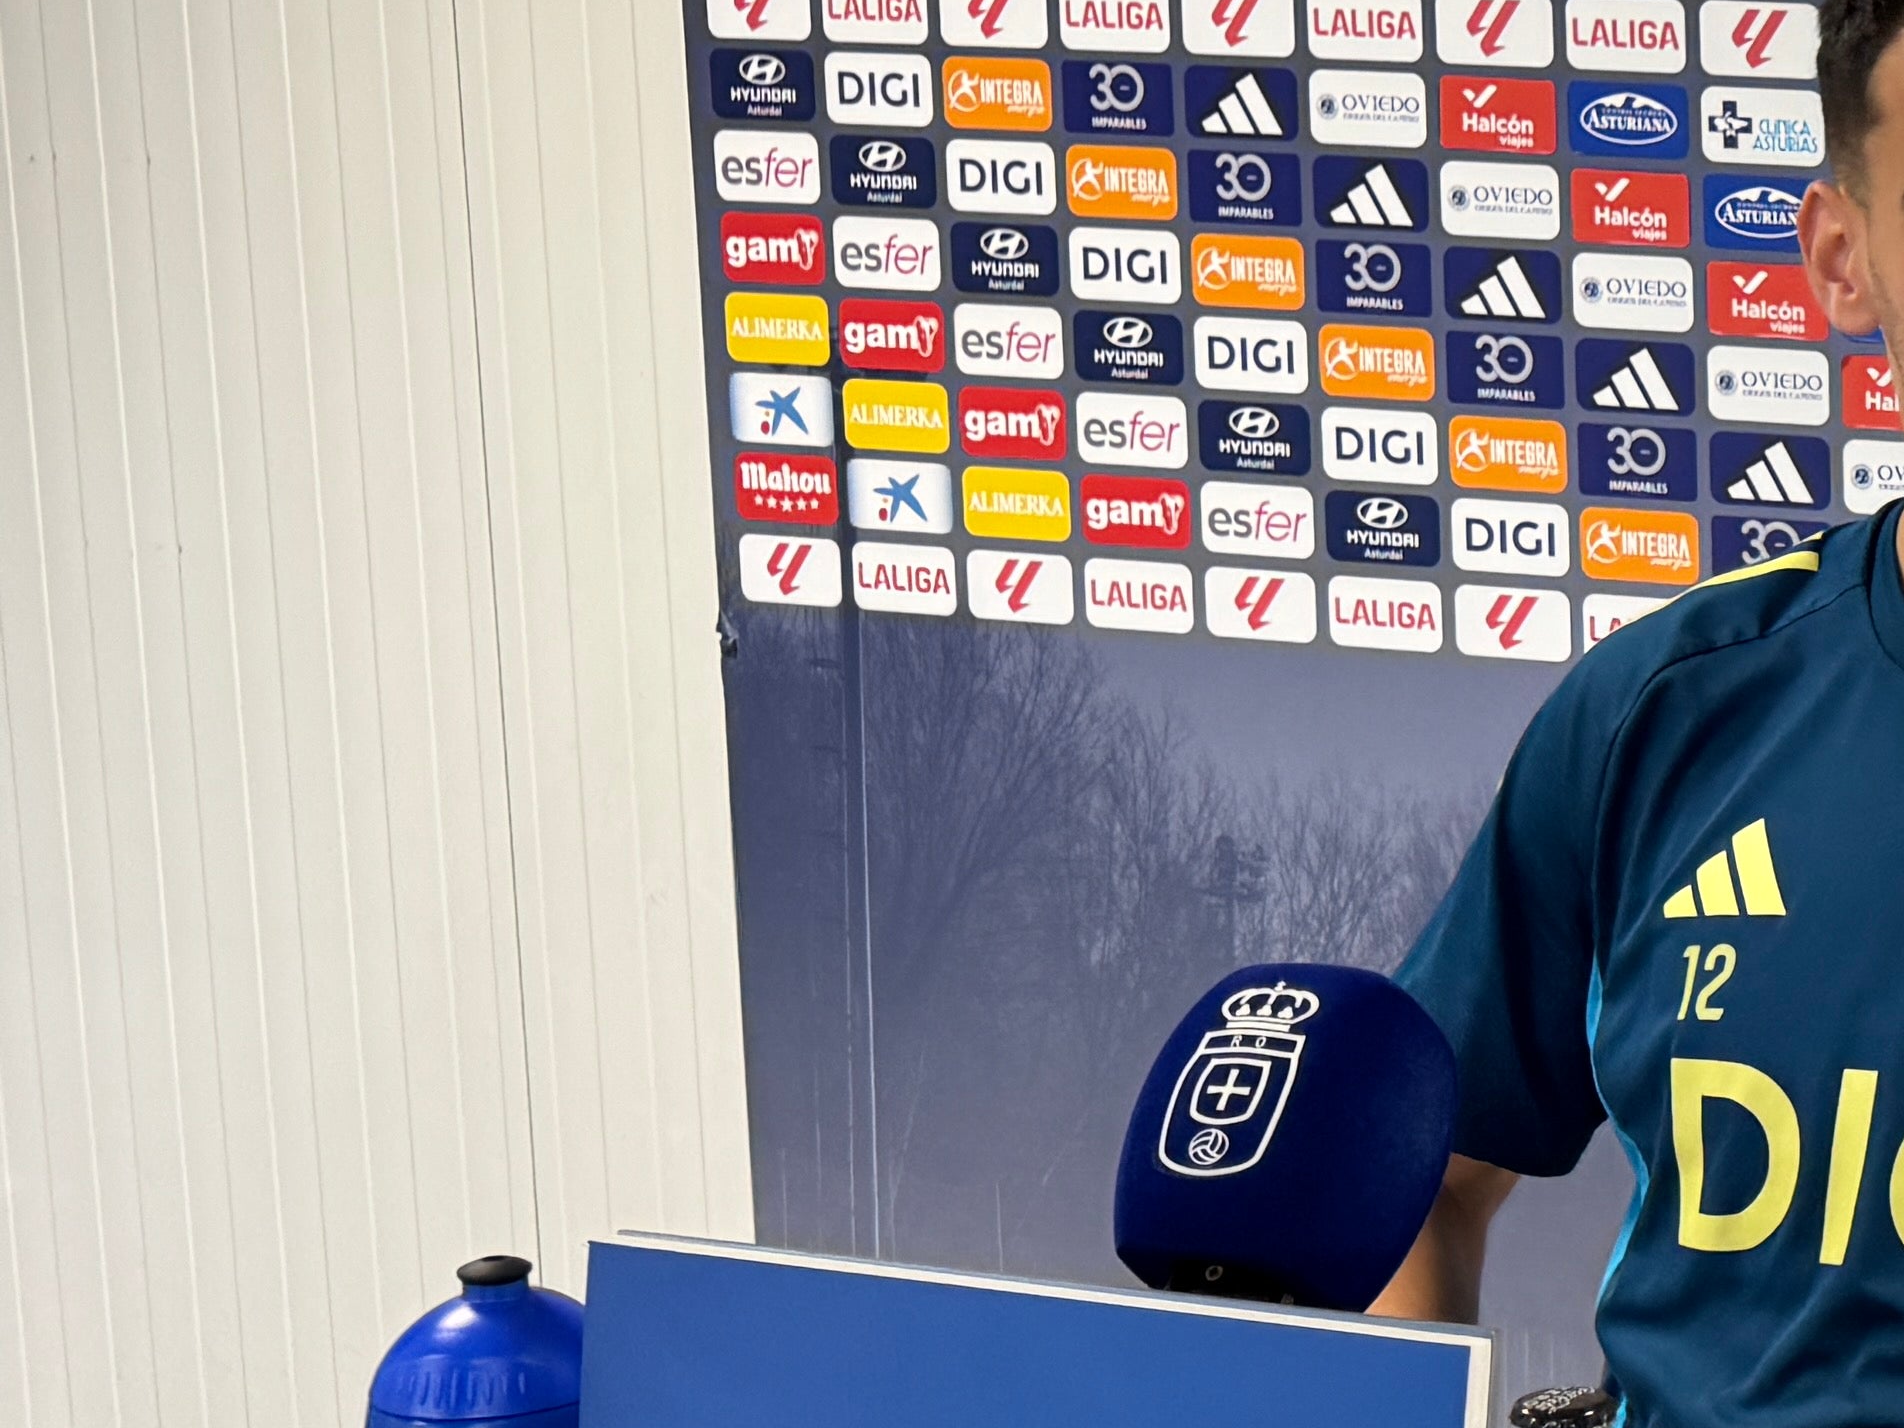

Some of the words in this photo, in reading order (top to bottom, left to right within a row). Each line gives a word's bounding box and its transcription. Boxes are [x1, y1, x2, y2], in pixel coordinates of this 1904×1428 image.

[730, 86, 796, 104] HYUNDAI
[838, 72, 919, 106] DIGI
[980, 78, 1044, 105] INTEGRA
[1463, 112, 1533, 134] Halcón
[1500, 135, 1533, 148] viajes
[734, 319, 821, 339] ALIMERKA
[1336, 427, 1423, 464] DIGI
[741, 462, 831, 495] Mahou
[1209, 502, 1306, 541] esfer
[858, 564, 951, 593] LALIGA
[1678, 943, 1737, 1022] 12
